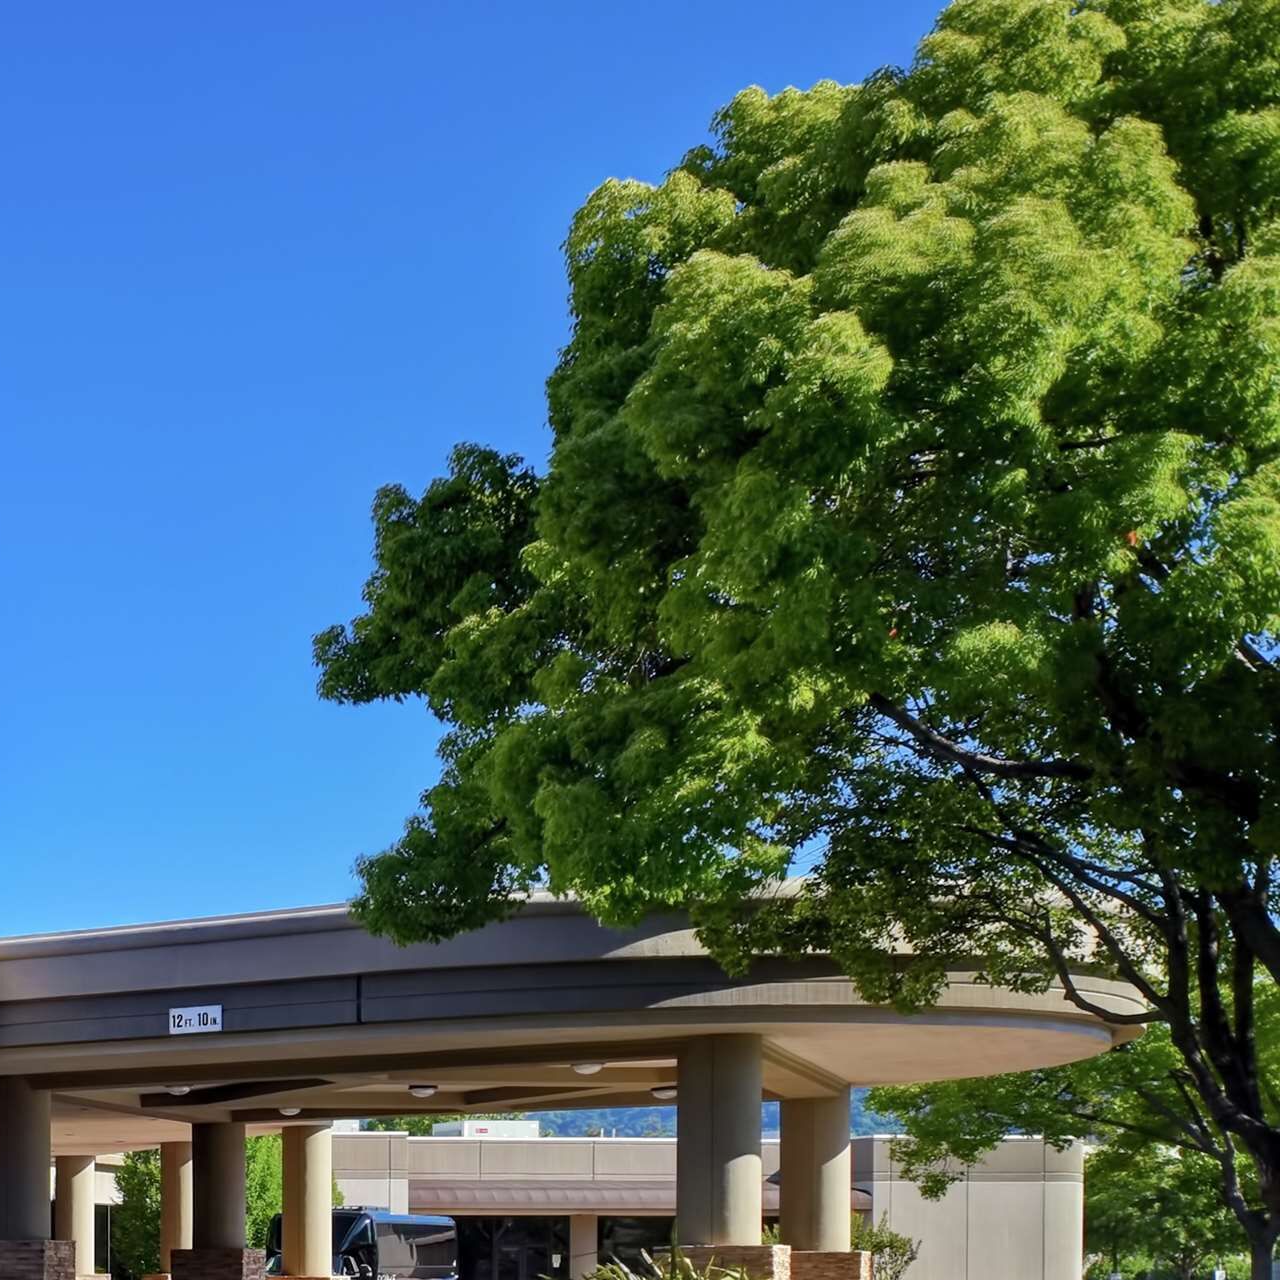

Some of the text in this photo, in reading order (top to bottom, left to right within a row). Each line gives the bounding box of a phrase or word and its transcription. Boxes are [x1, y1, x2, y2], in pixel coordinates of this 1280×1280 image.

[172, 1014, 183, 1028] 12
[185, 1018, 195, 1027] FT.
[197, 1012, 208, 1026] 10
